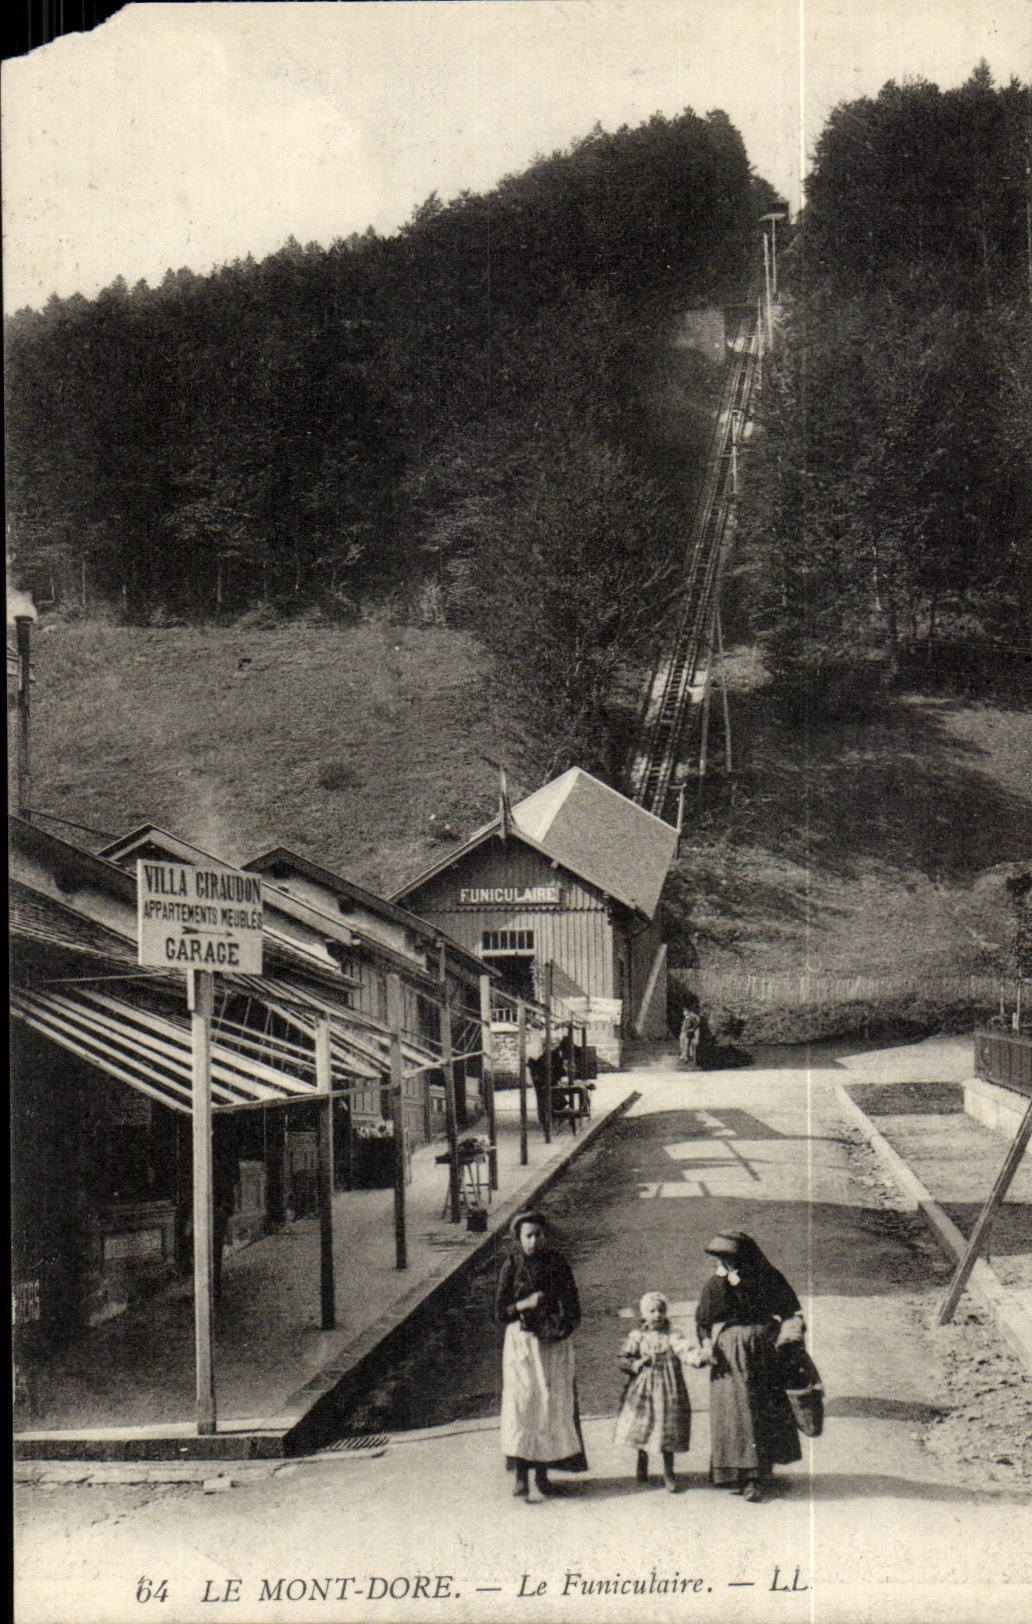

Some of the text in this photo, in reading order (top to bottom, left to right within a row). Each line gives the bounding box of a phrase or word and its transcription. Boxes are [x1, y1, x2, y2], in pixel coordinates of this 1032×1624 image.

[144, 865, 187, 897] VILLA
[460, 887, 557, 902] FUNICULAIRE
[144, 900, 217, 925] APPARTEMENTS
[165, 937, 240, 965] GARAGE
